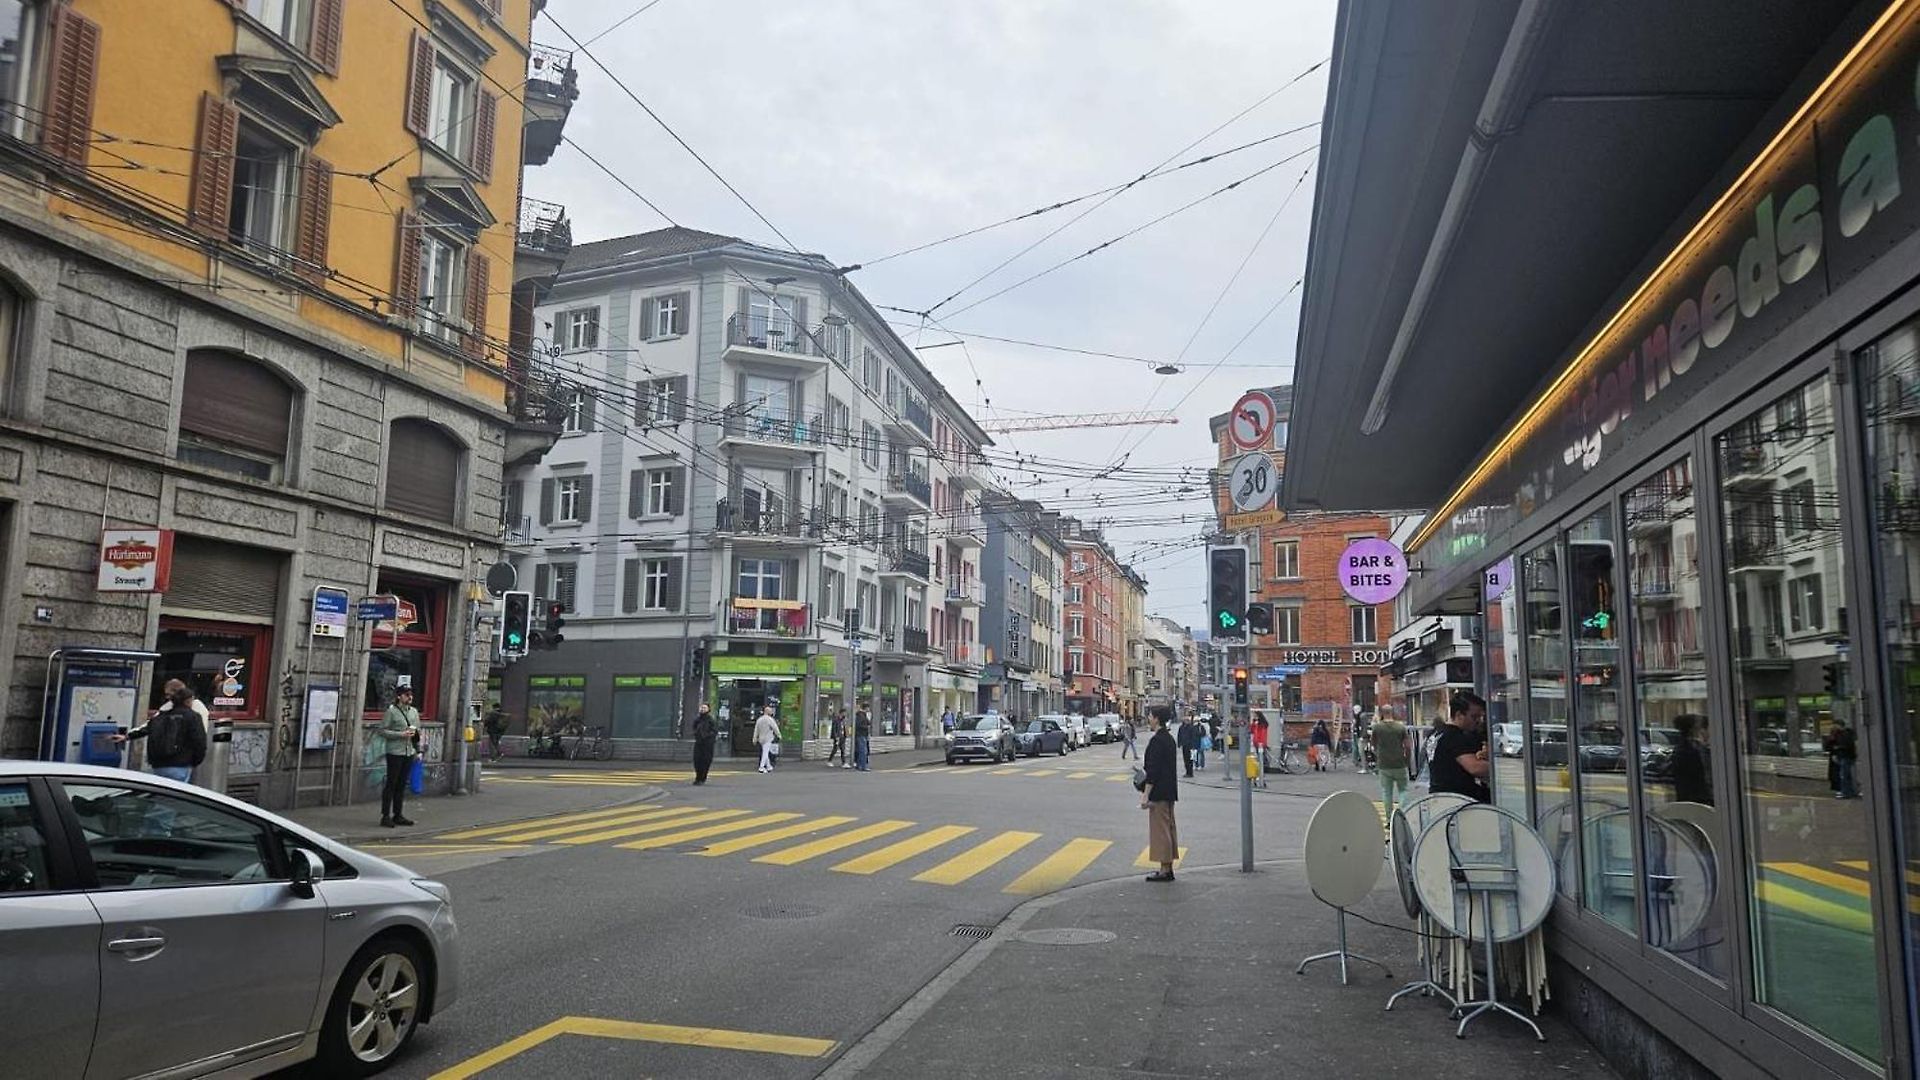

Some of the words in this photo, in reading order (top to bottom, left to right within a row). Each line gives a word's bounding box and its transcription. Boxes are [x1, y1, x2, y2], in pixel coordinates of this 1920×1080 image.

[1643, 183, 1822, 402] needs
[1838, 114, 1902, 238] a
[1243, 466, 1267, 497] 30
[1350, 556, 1379, 568] BAR
[1384, 555, 1393, 567] &
[1350, 574, 1391, 586] BITES
[1284, 650, 1342, 664] HOTEL
[1352, 650, 1392, 664] ROT
